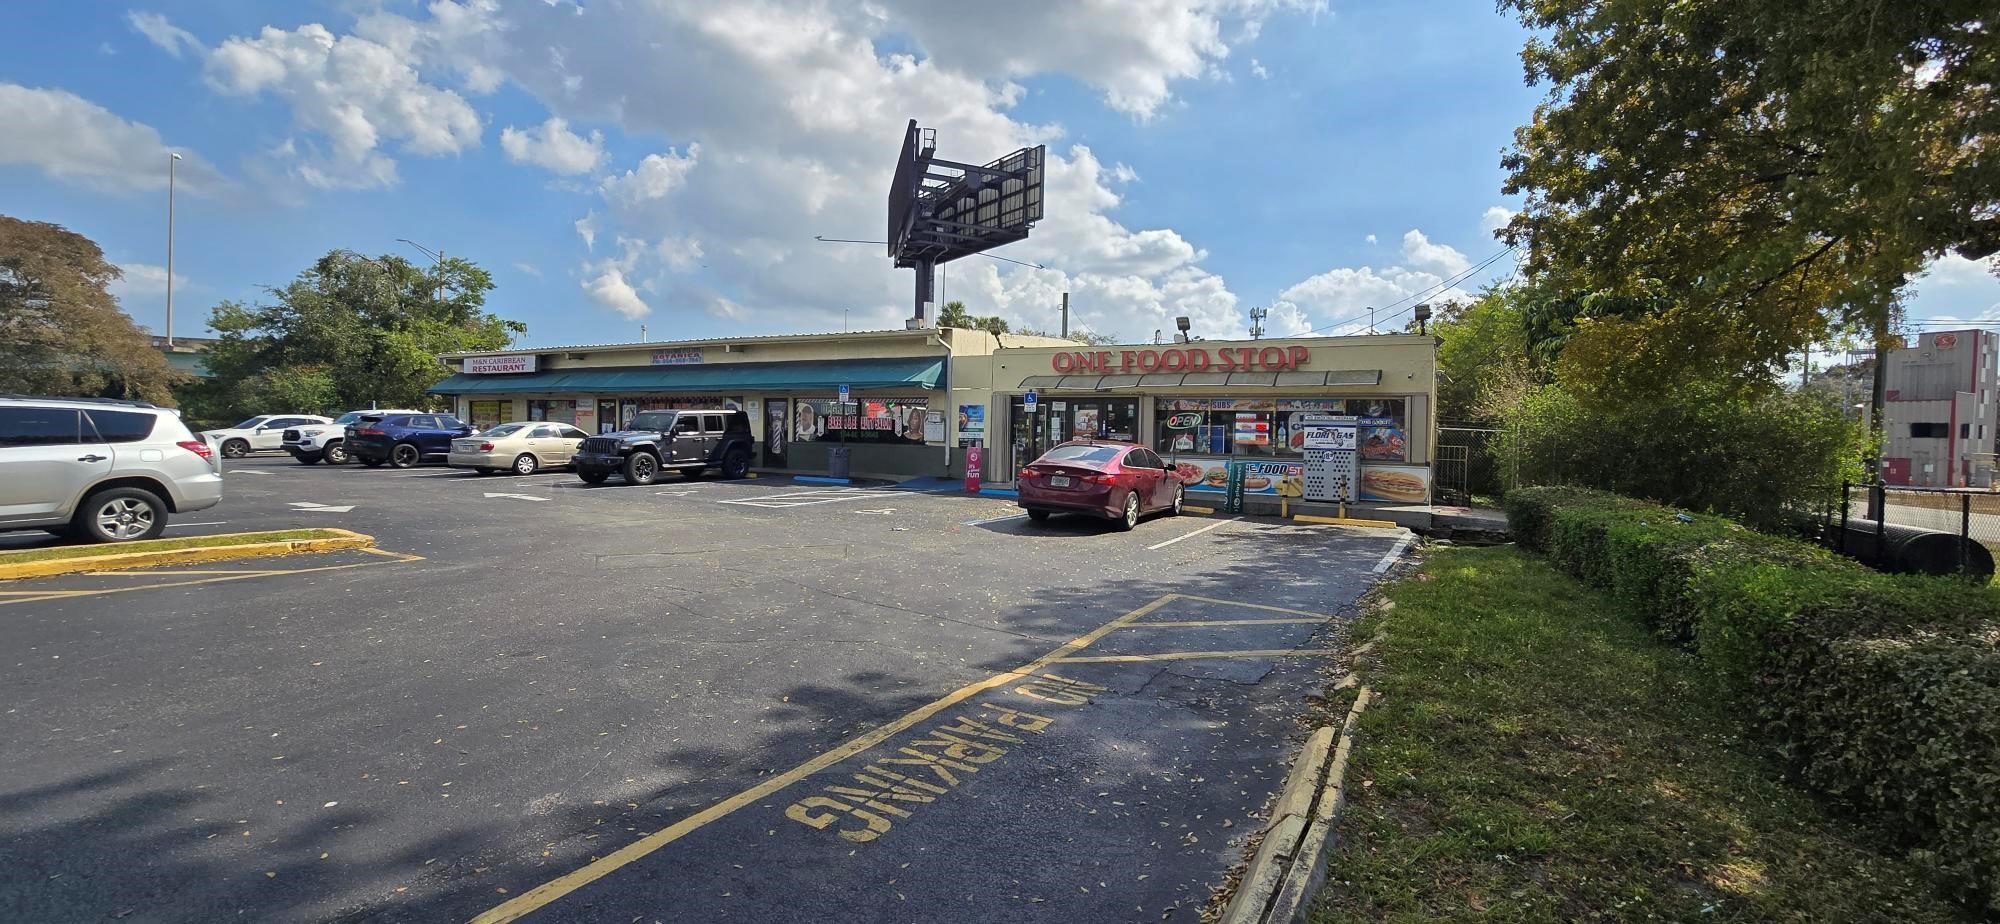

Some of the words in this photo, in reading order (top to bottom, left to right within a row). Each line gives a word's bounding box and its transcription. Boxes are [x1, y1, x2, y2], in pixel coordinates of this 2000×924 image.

[652, 352, 700, 360] BOTANICA
[1052, 350, 1113, 374] ONE
[1119, 348, 1211, 374] FOOD
[1217, 345, 1310, 373] STOP
[472, 363, 526, 372] RESTAURANT
[1212, 400, 1231, 409] SUBS
[1169, 415, 1199, 427] OPEN
[1306, 431, 1329, 439] FLORI
[1258, 463, 1288, 474] FOOD
[967, 470, 980, 478] fun
[1014, 673, 1108, 705] NO
[784, 702, 1055, 844] PARKING
